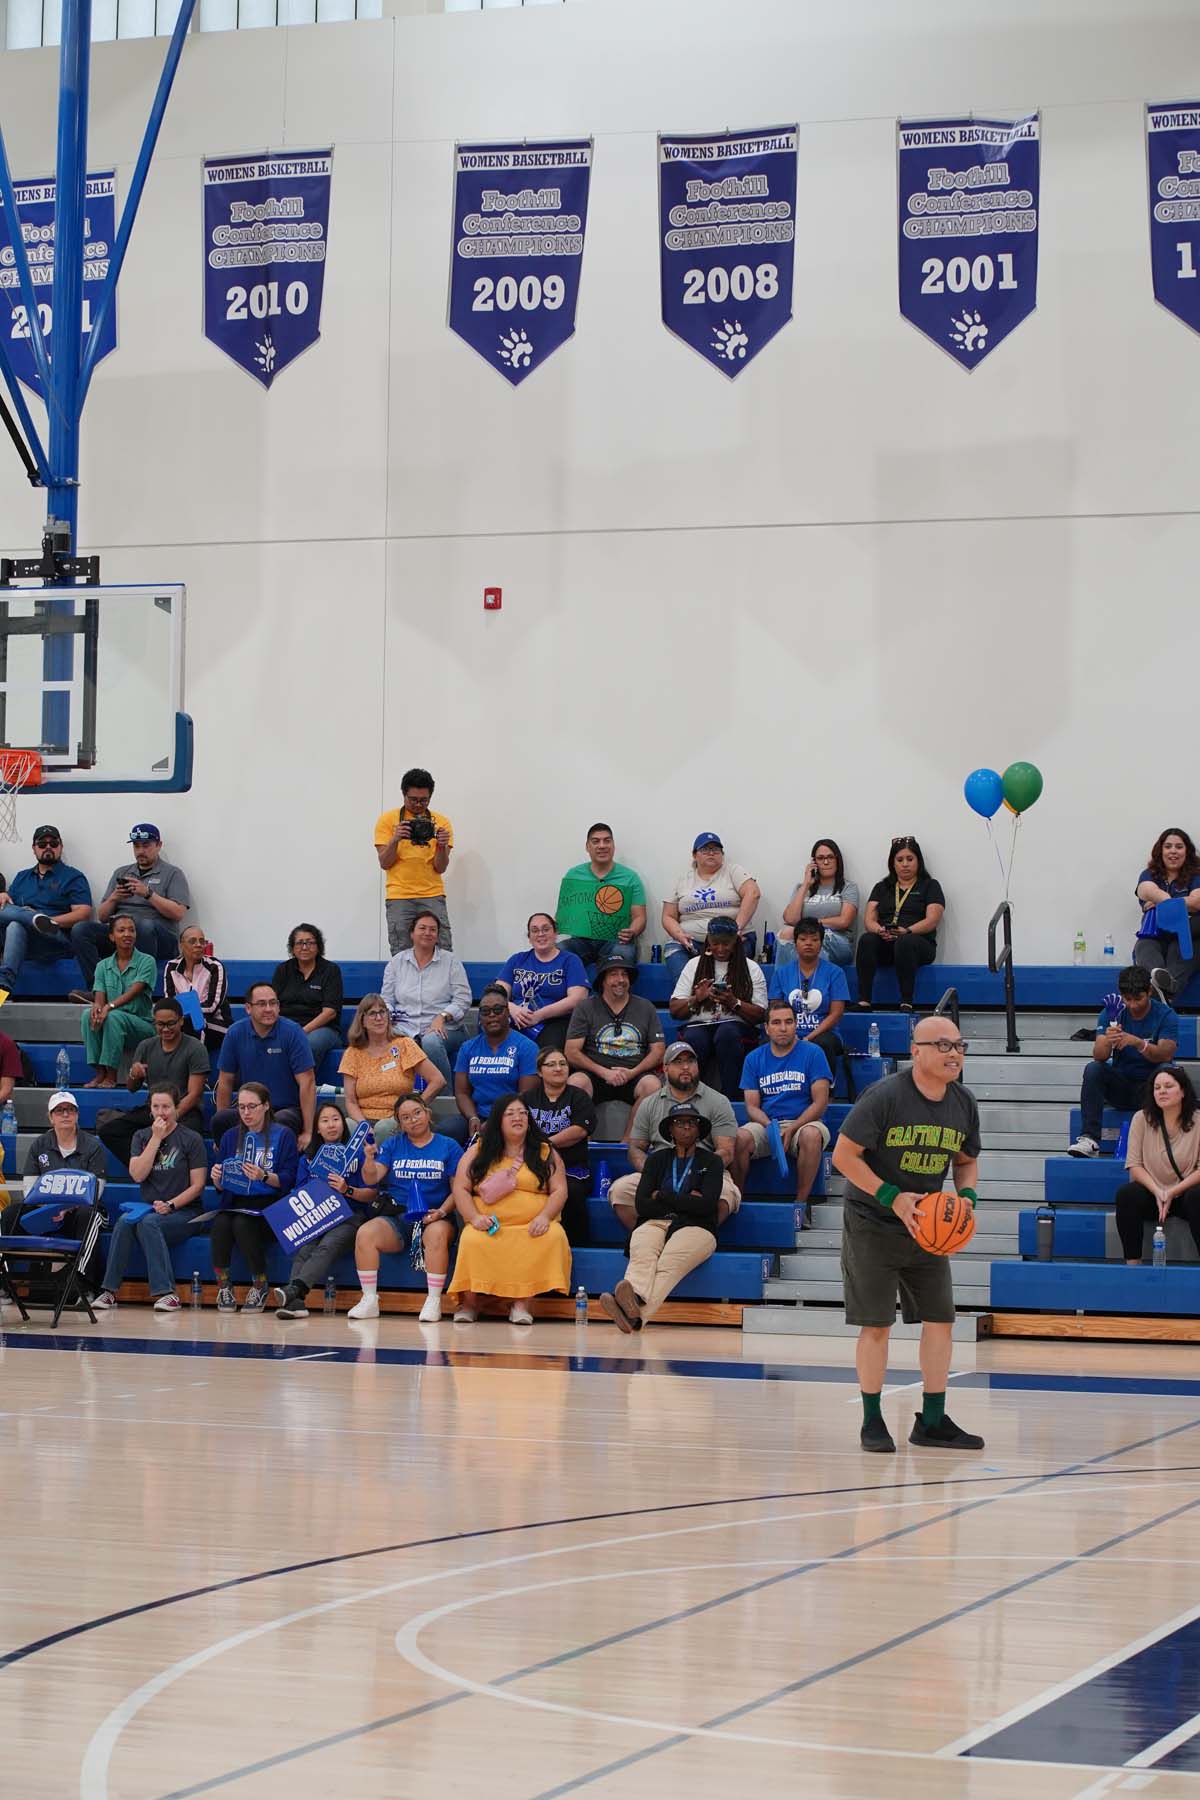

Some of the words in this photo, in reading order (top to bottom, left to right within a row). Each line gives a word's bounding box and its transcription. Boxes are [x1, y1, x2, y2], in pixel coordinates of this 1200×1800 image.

[1152, 113, 1200, 128] WOMEN
[663, 146, 714, 160] WOMENS
[716, 136, 793, 158] BASKETBALL
[902, 130, 956, 146] WOMENS
[207, 166, 255, 182] WOMENS
[257, 161, 328, 177] BASKETBALL
[460, 155, 509, 169] WOMENS
[512, 152, 587, 167] BASKETBALL
[687, 175, 769, 202] Foothill
[928, 163, 1009, 190] Foothill
[44, 181, 112, 200] BABALL
[481, 188, 561, 212] Foothill
[908, 190, 1033, 214] Conference
[231, 197, 304, 222] Foothill
[669, 201, 790, 227] Conference
[213, 222, 323, 246] Conference
[463, 212, 581, 234] Conference
[903, 209, 1036, 239] CHAMPIONS
[458, 234, 583, 258] CHAMPIONS
[665, 220, 793, 251] CHAMPIONS
[209, 241, 326, 269] CHAMPIONS
[683, 263, 779, 304] 2008
[920, 253, 1018, 294] 2001
[226, 281, 309, 320] 2010
[472, 275, 565, 312] 2009
[11, 300, 94, 339] 201
[796, 1013, 820, 1024] BVC
[886, 1125, 942, 1147] CRAFTON
[393, 1159, 405, 1170] SAN
[394, 1170, 416, 1179] VALLEY
[416, 1171, 442, 1179] COLLEGE
[39, 1175, 90, 1195] SBVC
[288, 1190, 315, 1217] GO
[282, 1195, 341, 1242] WOLVERINES
